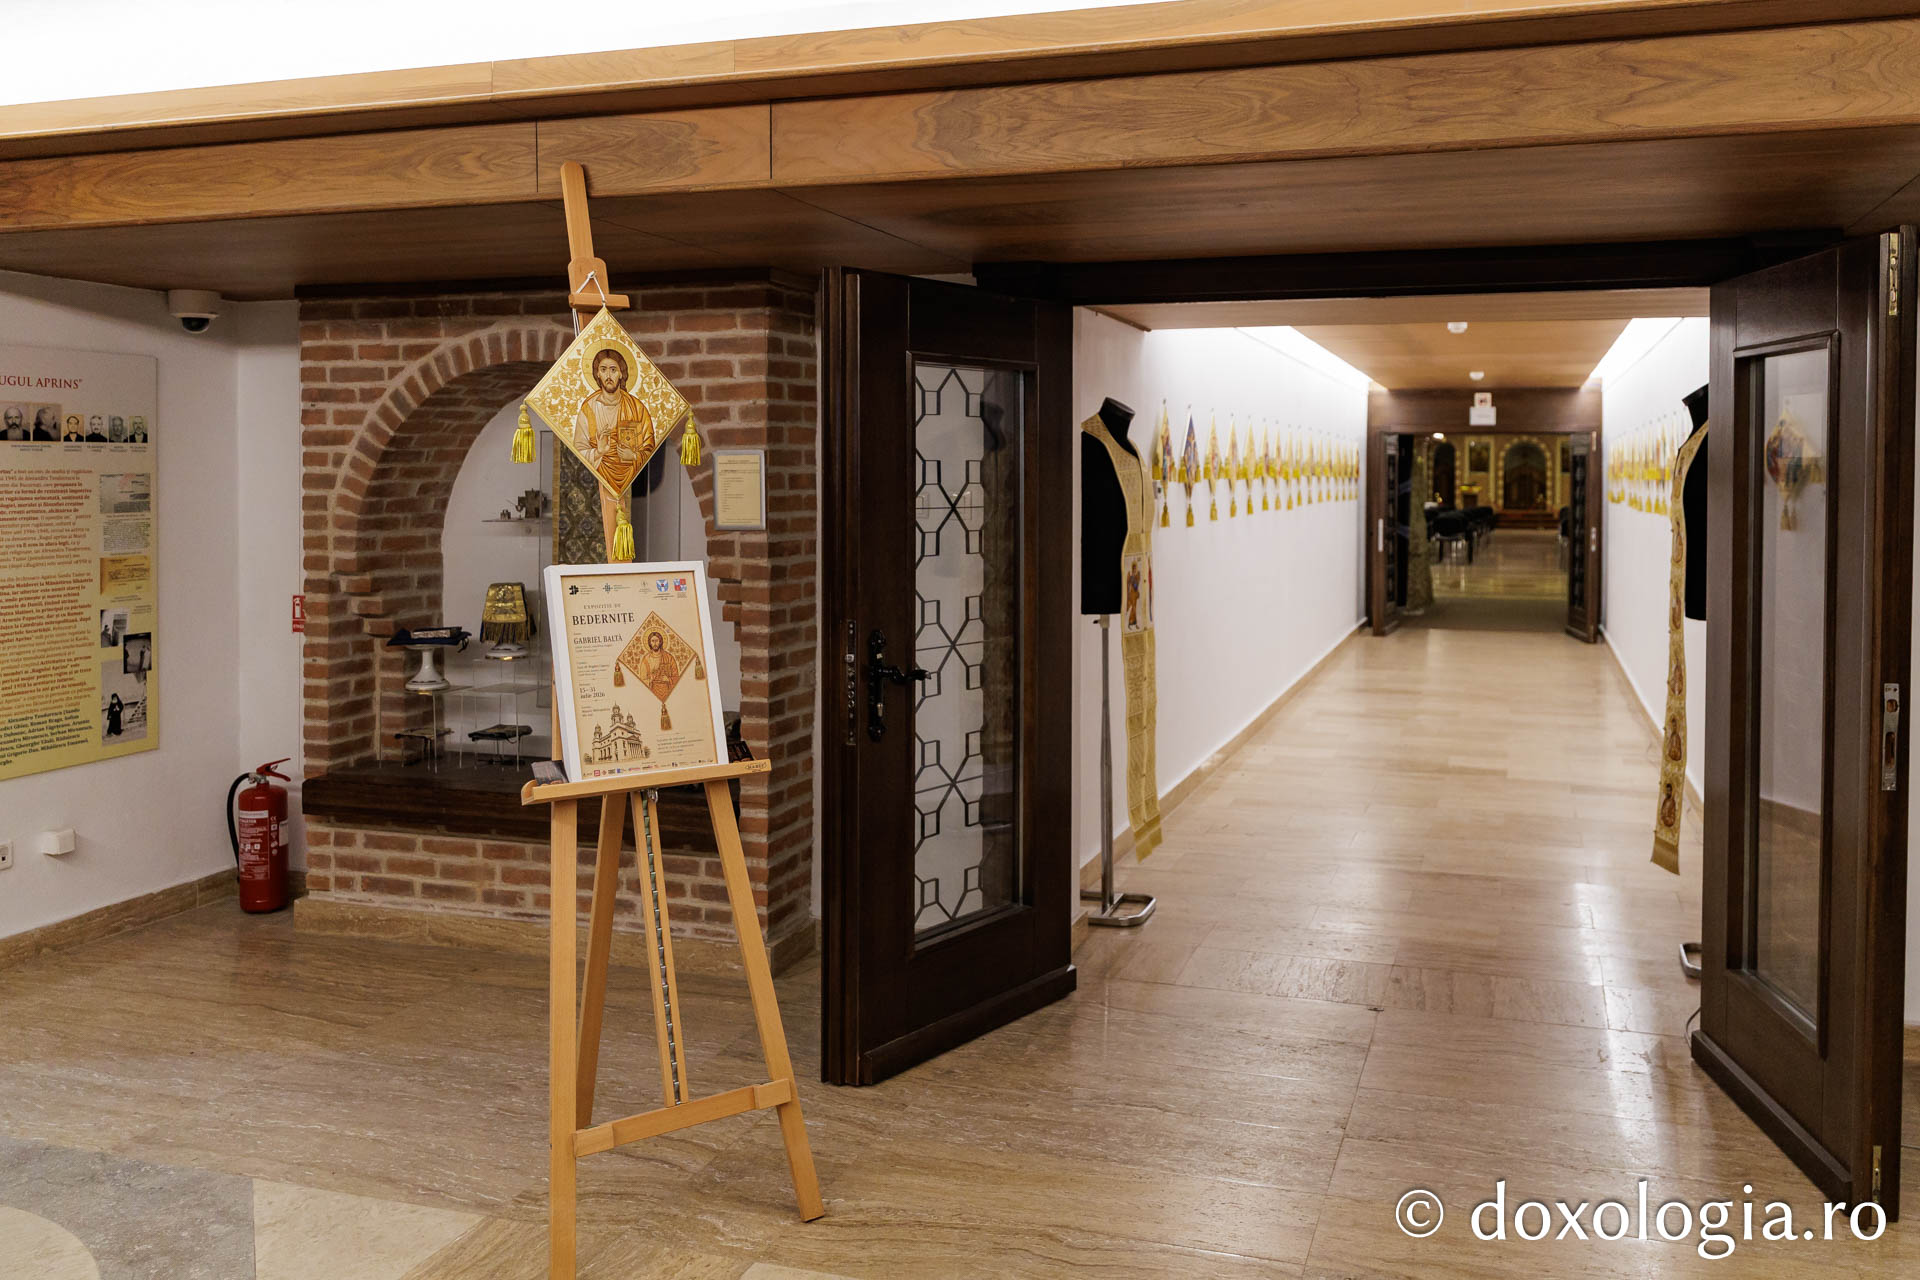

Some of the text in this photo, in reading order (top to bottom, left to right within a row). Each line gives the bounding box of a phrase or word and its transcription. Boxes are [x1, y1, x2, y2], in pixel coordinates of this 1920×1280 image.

[0, 375, 33, 387] UGUL
[572, 612, 635, 625] BEDERNIȚE
[574, 636, 601, 645] GABRIEL
